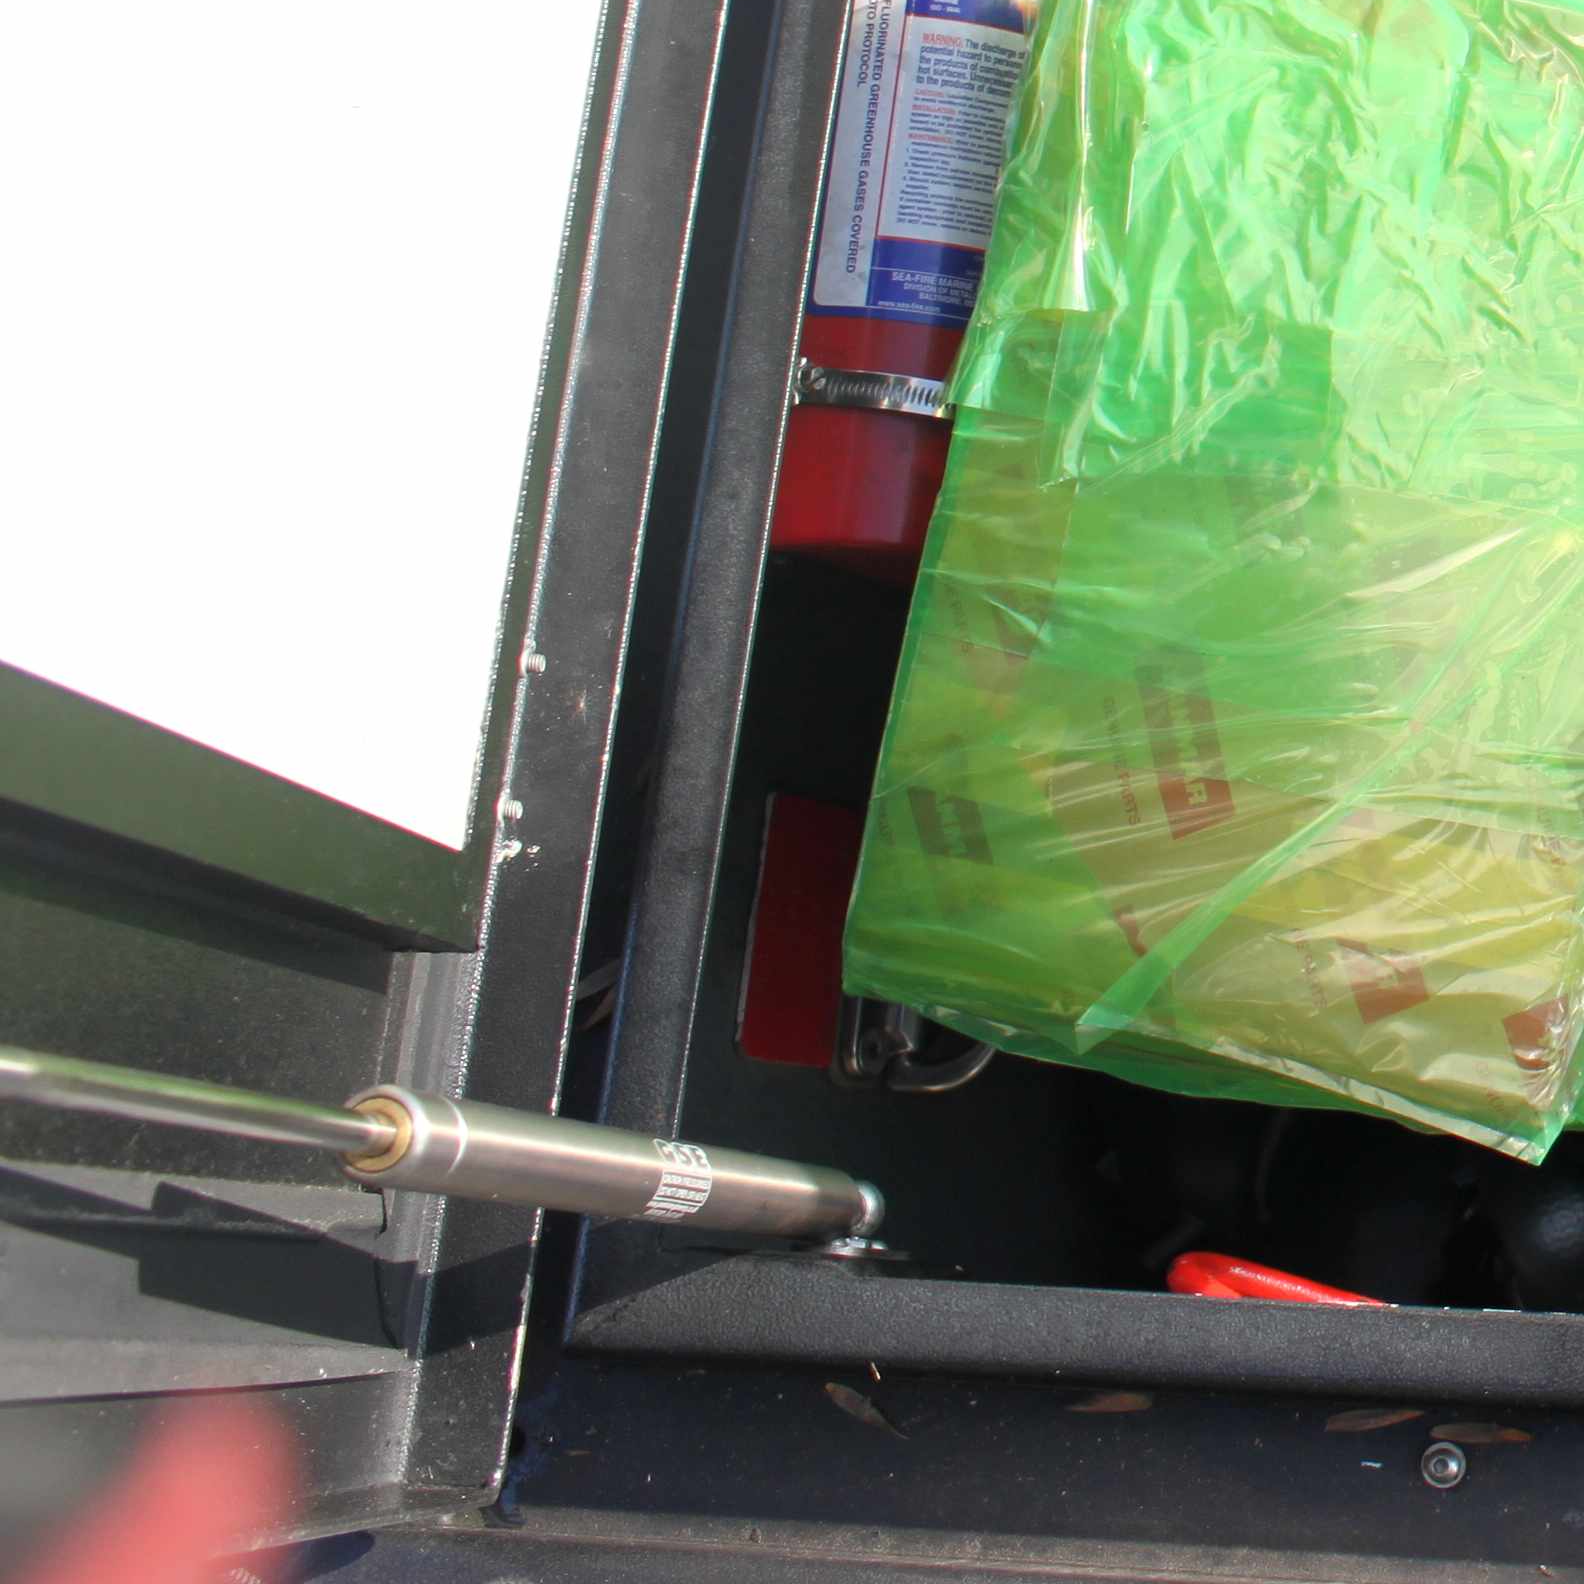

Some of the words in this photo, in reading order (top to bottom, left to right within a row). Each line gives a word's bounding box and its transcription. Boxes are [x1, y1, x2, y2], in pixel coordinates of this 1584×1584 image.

[871, 0, 892, 80] FLUORINATED
[965, 38, 980, 50] The
[981, 42, 1017, 59] discharge
[857, 23, 875, 88] PROTOCOL
[919, 56, 931, 65] the
[933, 57, 968, 71] products
[920, 45, 954, 57] potential
[957, 49, 982, 61] hazard
[918, 65, 931, 75] hot
[926, 76, 939, 85] the
[940, 79, 975, 91] products
[860, 83, 881, 167] GREENHOUSE
[854, 170, 869, 212] GASES
[846, 214, 863, 273] COVERED
[892, 272, 937, 286] SEA-FIRE
